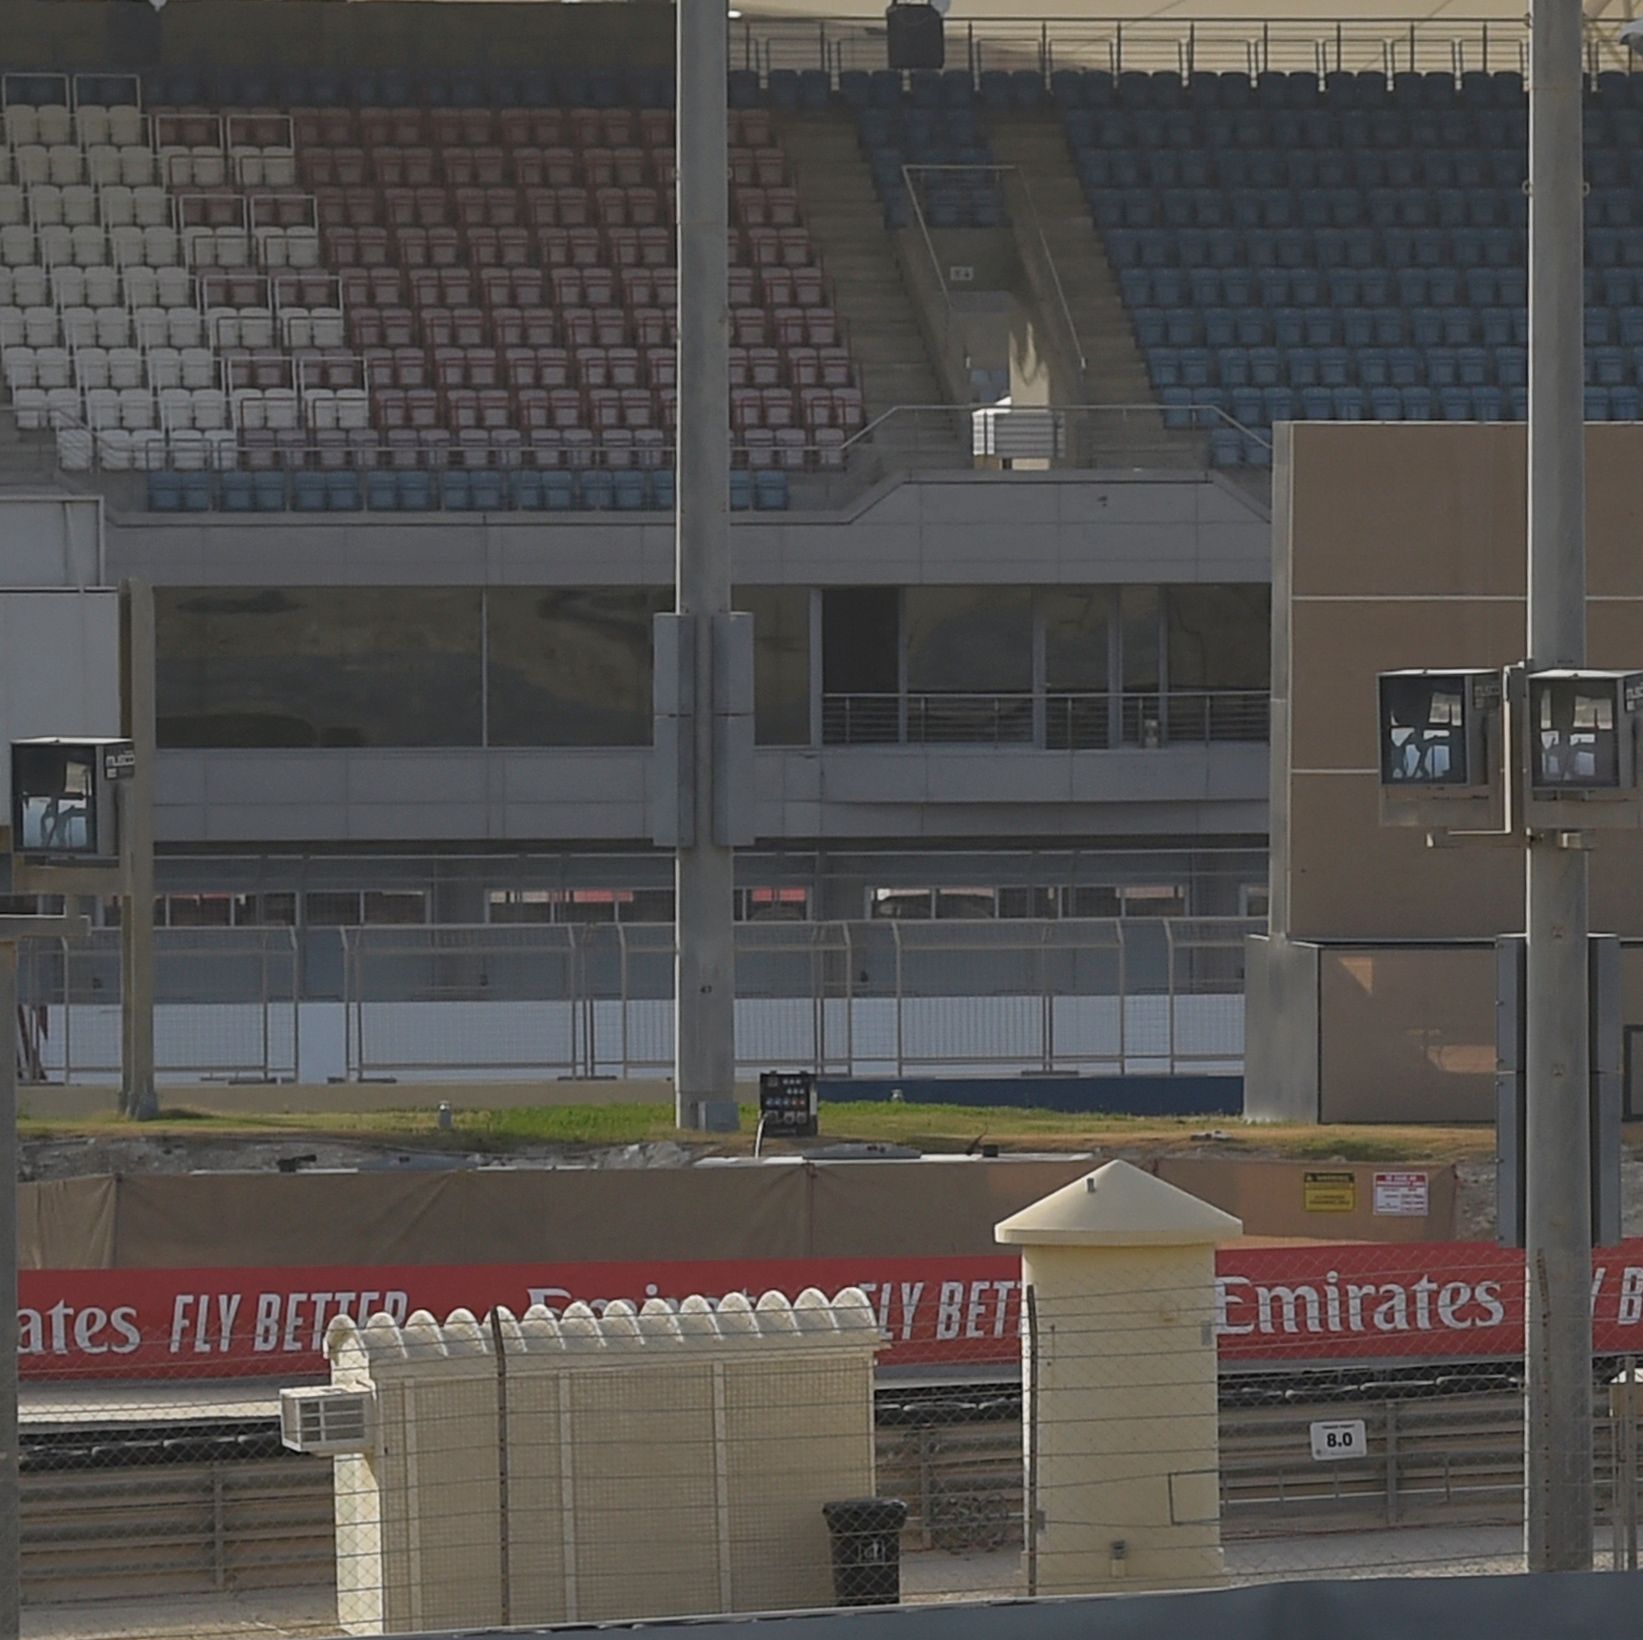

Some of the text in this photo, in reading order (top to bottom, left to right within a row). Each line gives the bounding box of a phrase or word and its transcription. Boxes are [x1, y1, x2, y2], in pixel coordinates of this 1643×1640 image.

[170, 1294, 241, 1354] FLY
[1216, 1271, 1505, 1335] Emirates
[1327, 1432, 1353, 1447] 8.0
